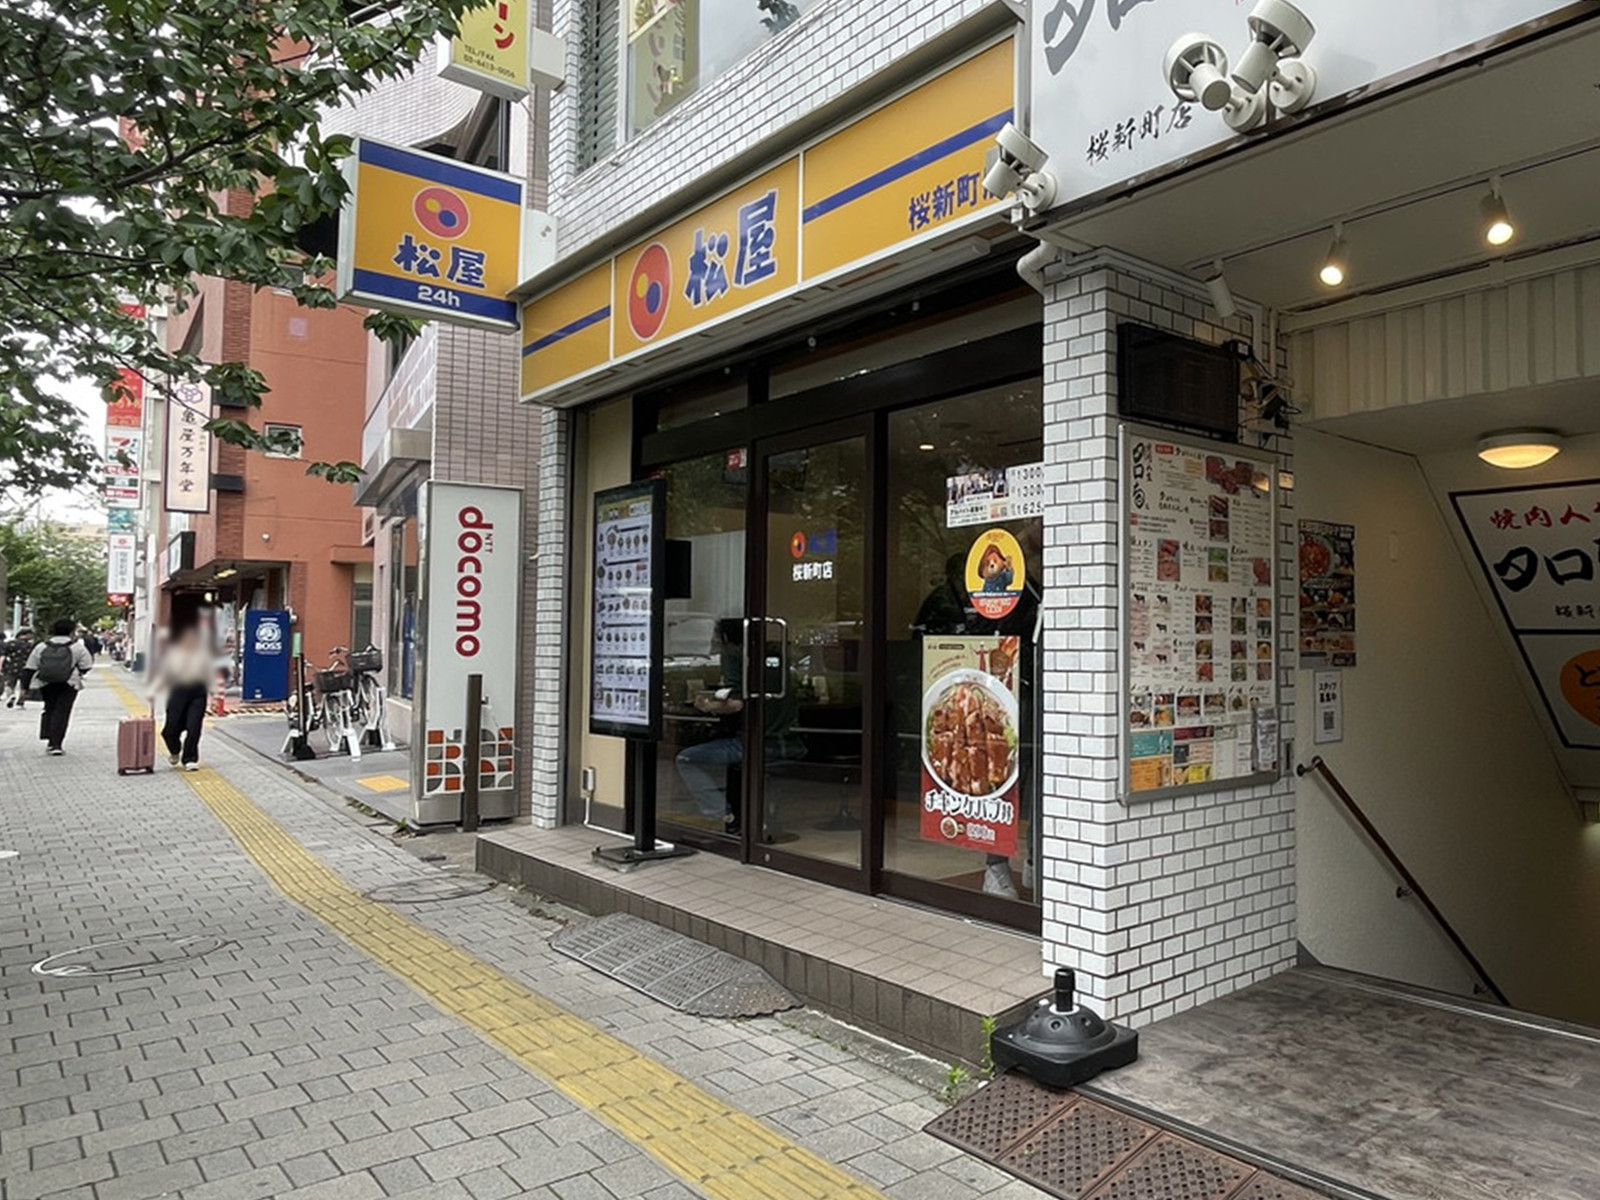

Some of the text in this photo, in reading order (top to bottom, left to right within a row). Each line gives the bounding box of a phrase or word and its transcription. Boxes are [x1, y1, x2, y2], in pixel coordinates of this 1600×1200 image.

[1086, 102, 1193, 166] 桜新町店
[393, 233, 486, 289] 松屋
[682, 189, 779, 309] 松屋
[417, 285, 460, 307] 24h
[484, 532, 493, 554] NTT
[1493, 538, 1600, 592] タロ
[455, 506, 494, 658] docomo
[255, 641, 282, 650] BOSS
